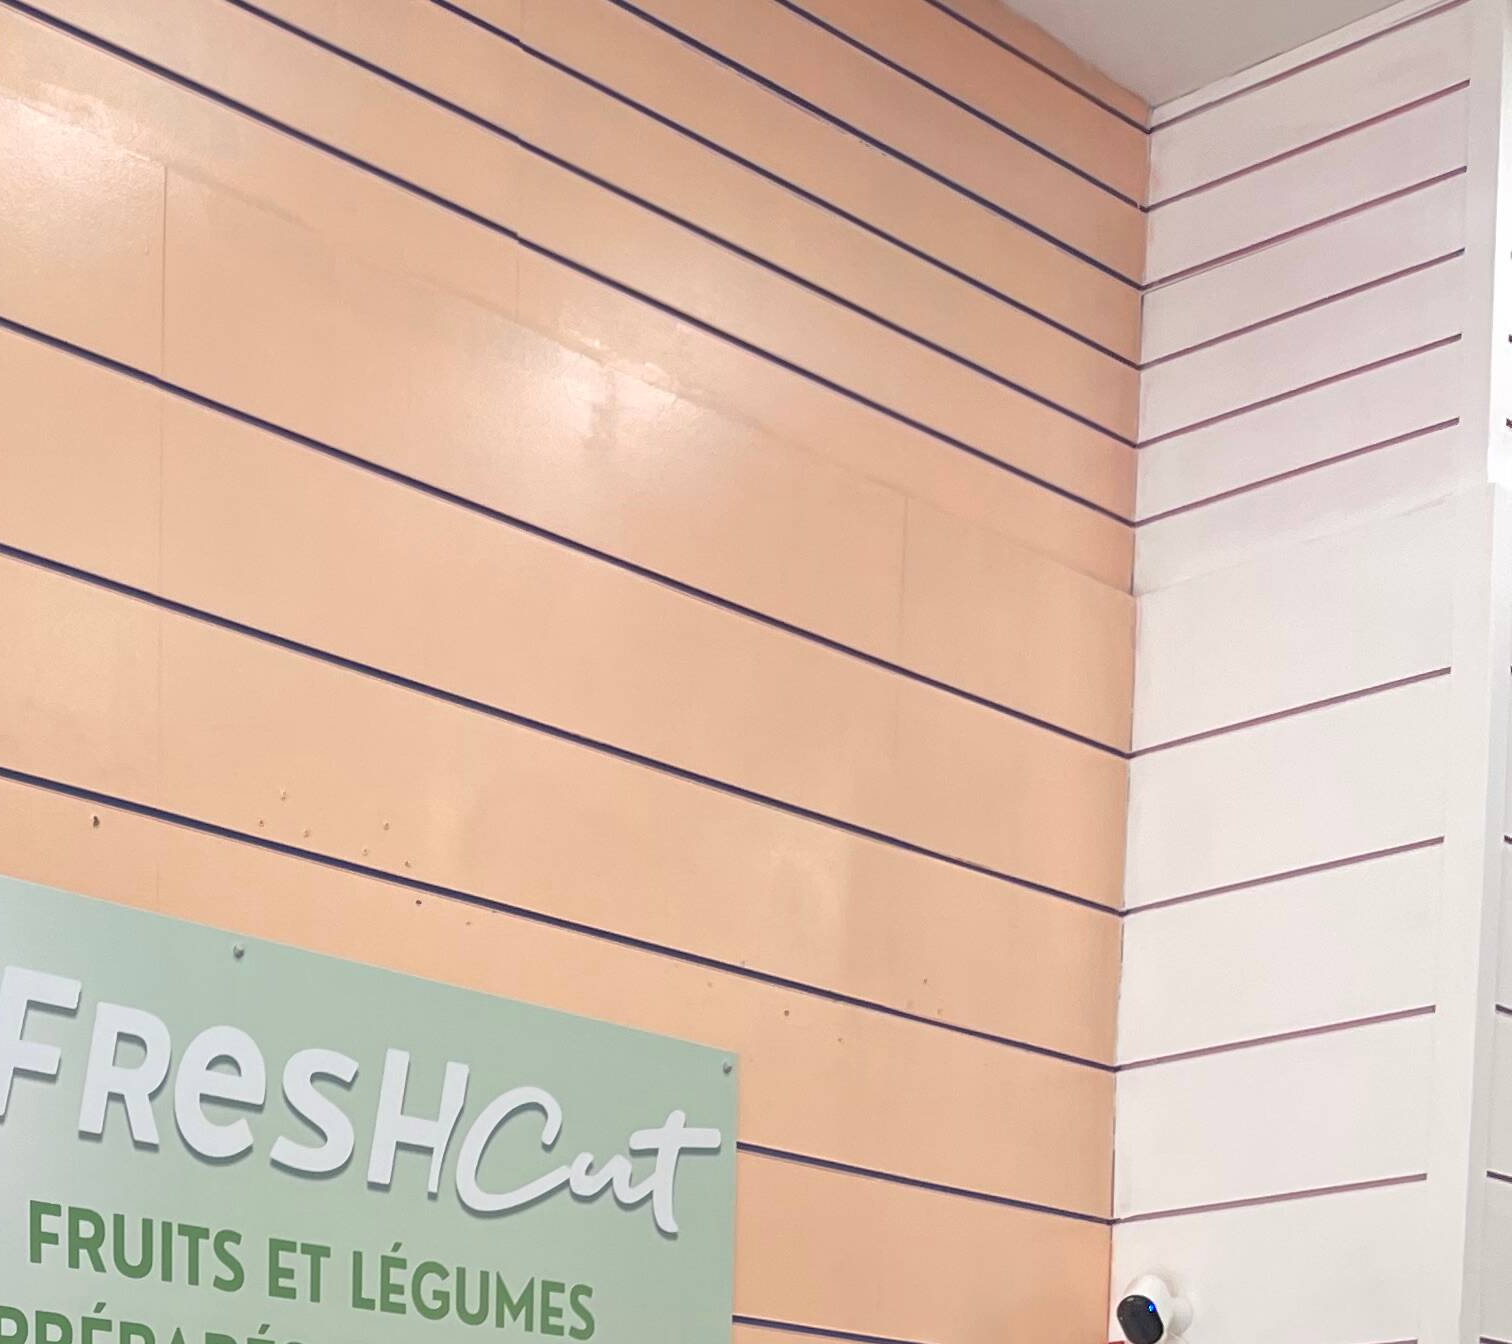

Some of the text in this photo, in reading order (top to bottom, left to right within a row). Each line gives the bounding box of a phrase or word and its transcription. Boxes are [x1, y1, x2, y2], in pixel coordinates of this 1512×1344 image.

[28, 1200, 596, 1343] FRUITS ET LÉGUMES
